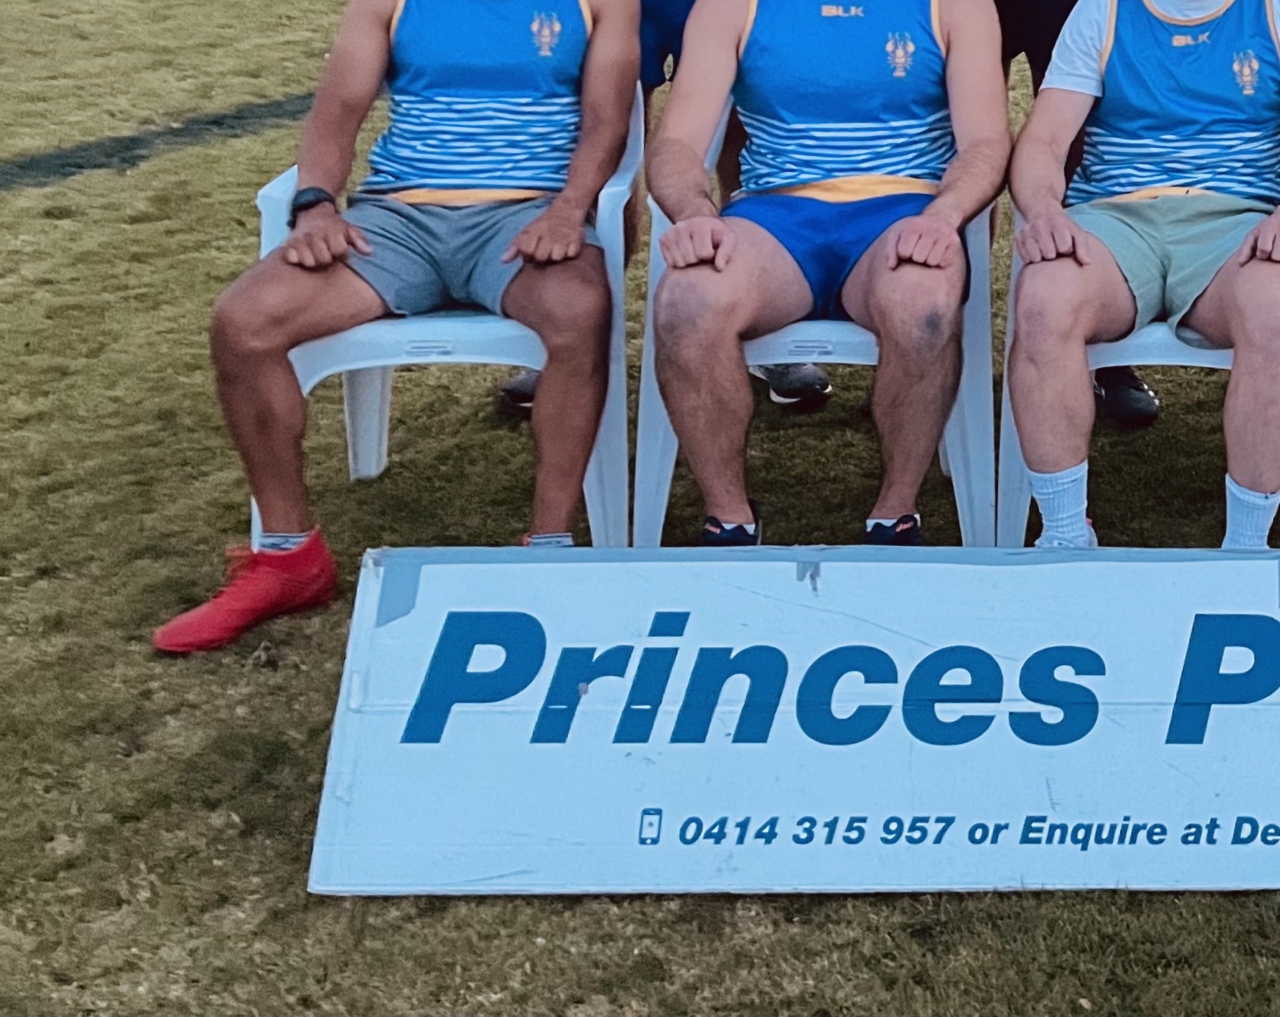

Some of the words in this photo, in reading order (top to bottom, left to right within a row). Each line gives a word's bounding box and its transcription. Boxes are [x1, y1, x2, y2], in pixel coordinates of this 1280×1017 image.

[821, 4, 865, 17] BLK
[1172, 31, 1210, 47] BLK
[399, 609, 1107, 747] Princes
[678, 815, 779, 846] 0414
[791, 815, 869, 846] 315
[879, 815, 956, 846] 957
[967, 822, 1010, 846] or
[1018, 815, 1168, 852] Enquire
[1180, 816, 1221, 846] at
